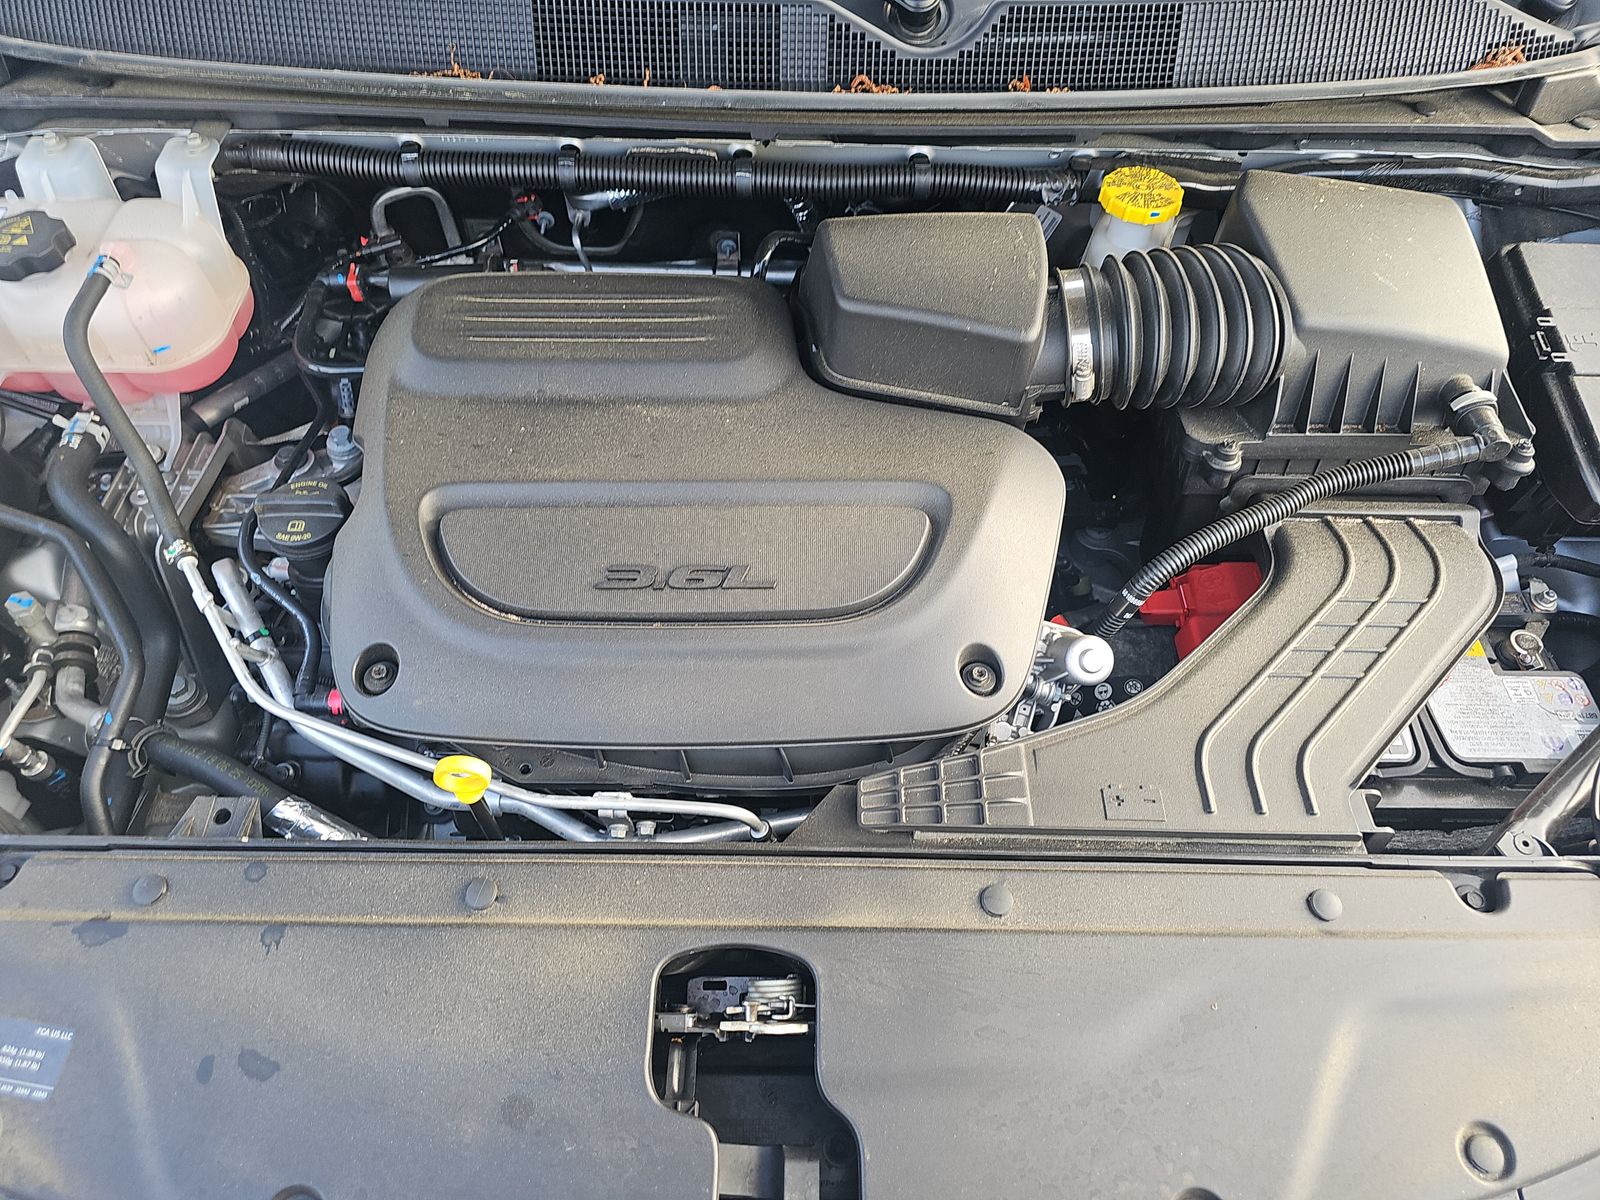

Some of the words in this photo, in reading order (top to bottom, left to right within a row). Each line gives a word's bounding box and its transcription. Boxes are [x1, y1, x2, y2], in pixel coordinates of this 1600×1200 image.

[290, 480, 317, 490] ENGINE
[318, 481, 329, 490] OIL
[275, 532, 290, 542] SAE
[593, 564, 777, 591] 3.6L
[50, 1029, 61, 1038] US
[60, 1031, 74, 1041] LLC
